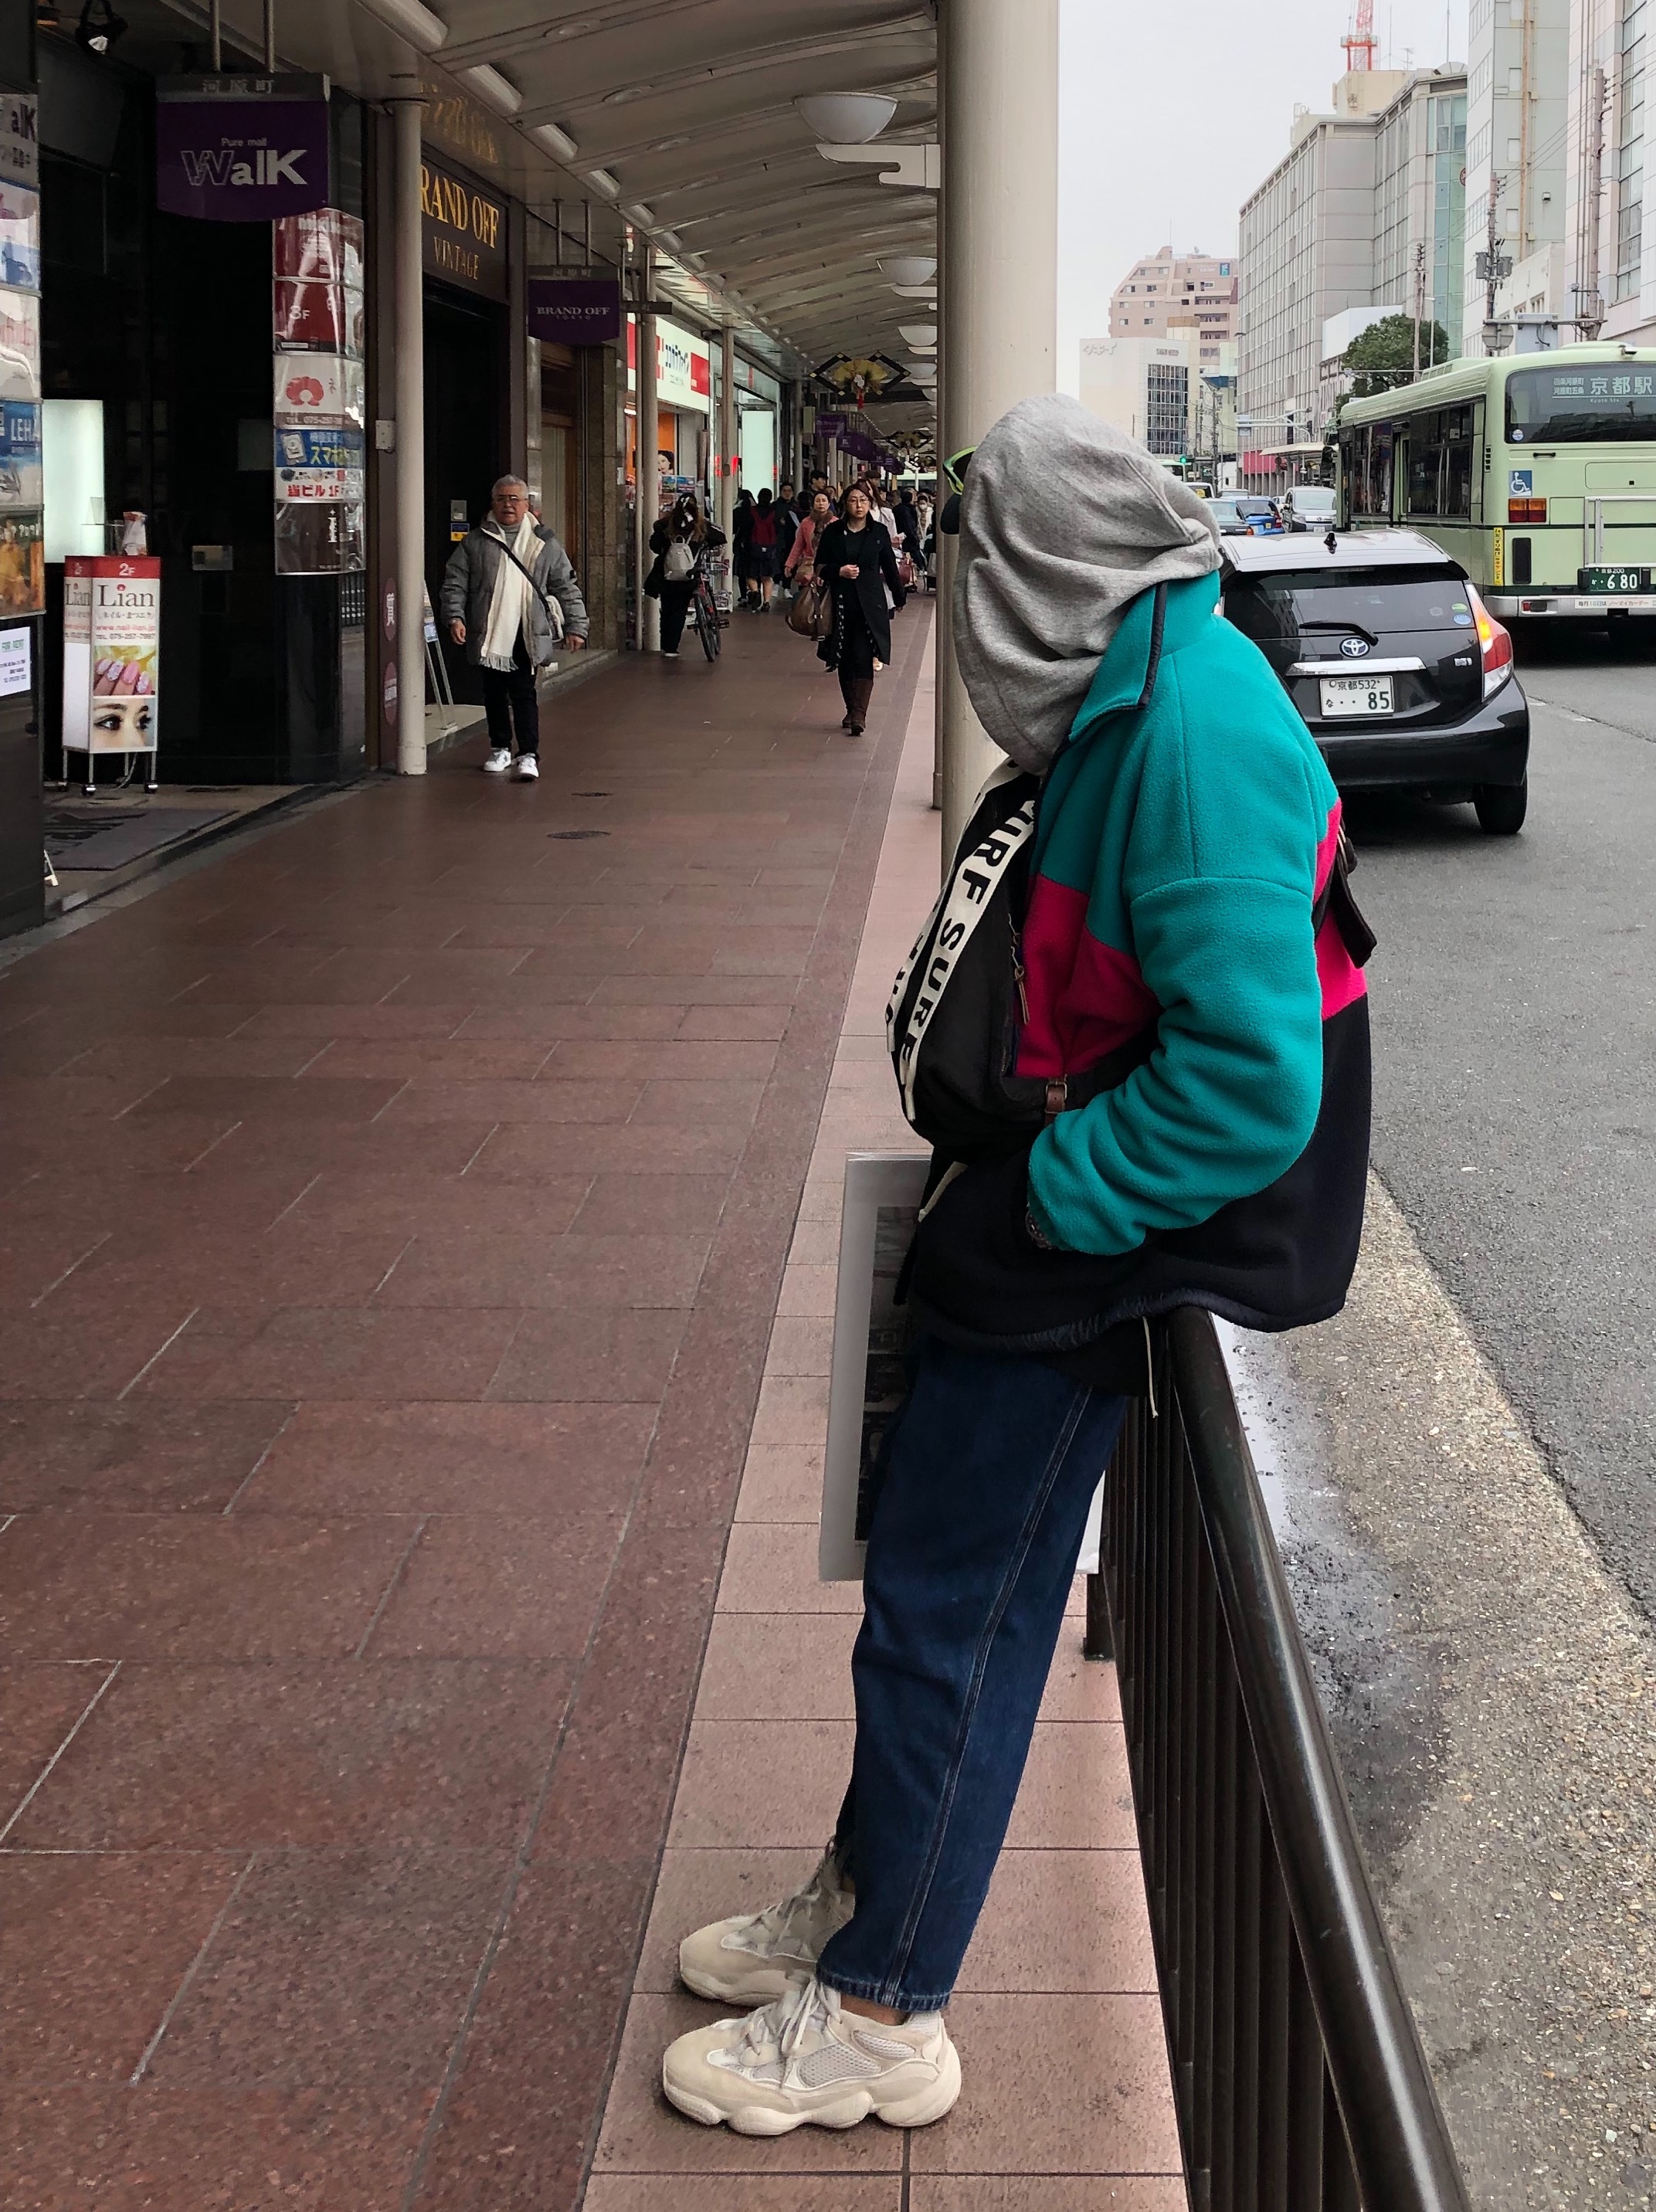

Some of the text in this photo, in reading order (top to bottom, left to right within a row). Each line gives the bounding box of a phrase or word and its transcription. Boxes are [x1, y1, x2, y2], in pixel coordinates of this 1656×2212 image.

[221, 137, 267, 146] Pure mall
[471, 195, 500, 249] OFF
[433, 236, 480, 280] VINTAGE
[537, 307, 610, 315] BRAND OFF
[1590, 376, 1653, 395] 京都駅
[119, 563, 135, 576] 2F
[97, 584, 154, 607] Lian
